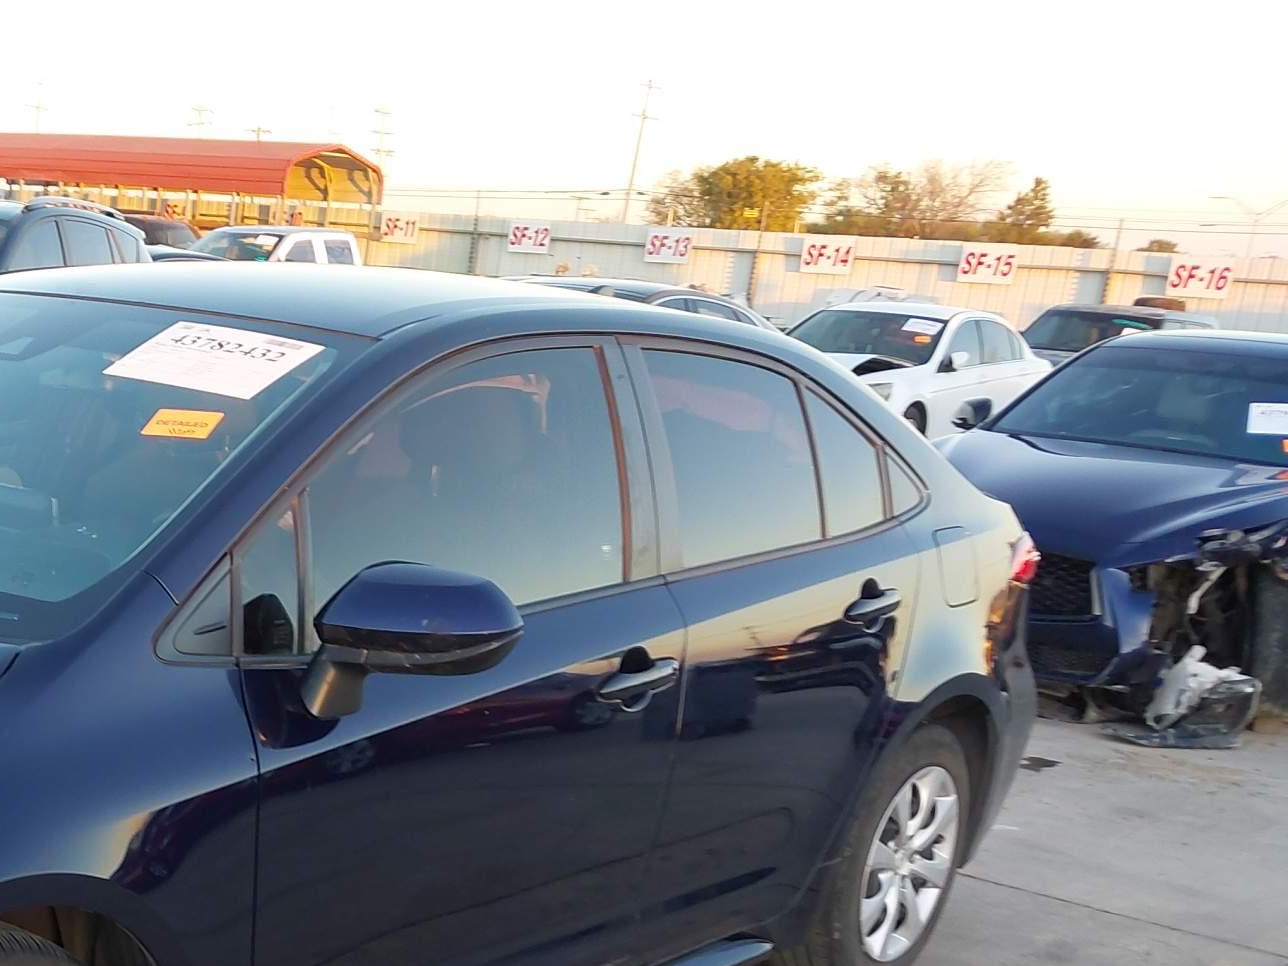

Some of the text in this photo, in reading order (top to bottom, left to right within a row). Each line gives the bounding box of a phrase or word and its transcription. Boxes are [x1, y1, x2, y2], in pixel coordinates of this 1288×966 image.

[382, 217, 417, 238] SF-11
[509, 226, 551, 247] SF-12
[647, 234, 692, 257] SF-13
[803, 243, 853, 267] SF-14
[960, 251, 1017, 277] SF-15
[1170, 263, 1233, 291] SF-16
[170, 333, 287, 362] 43782432
